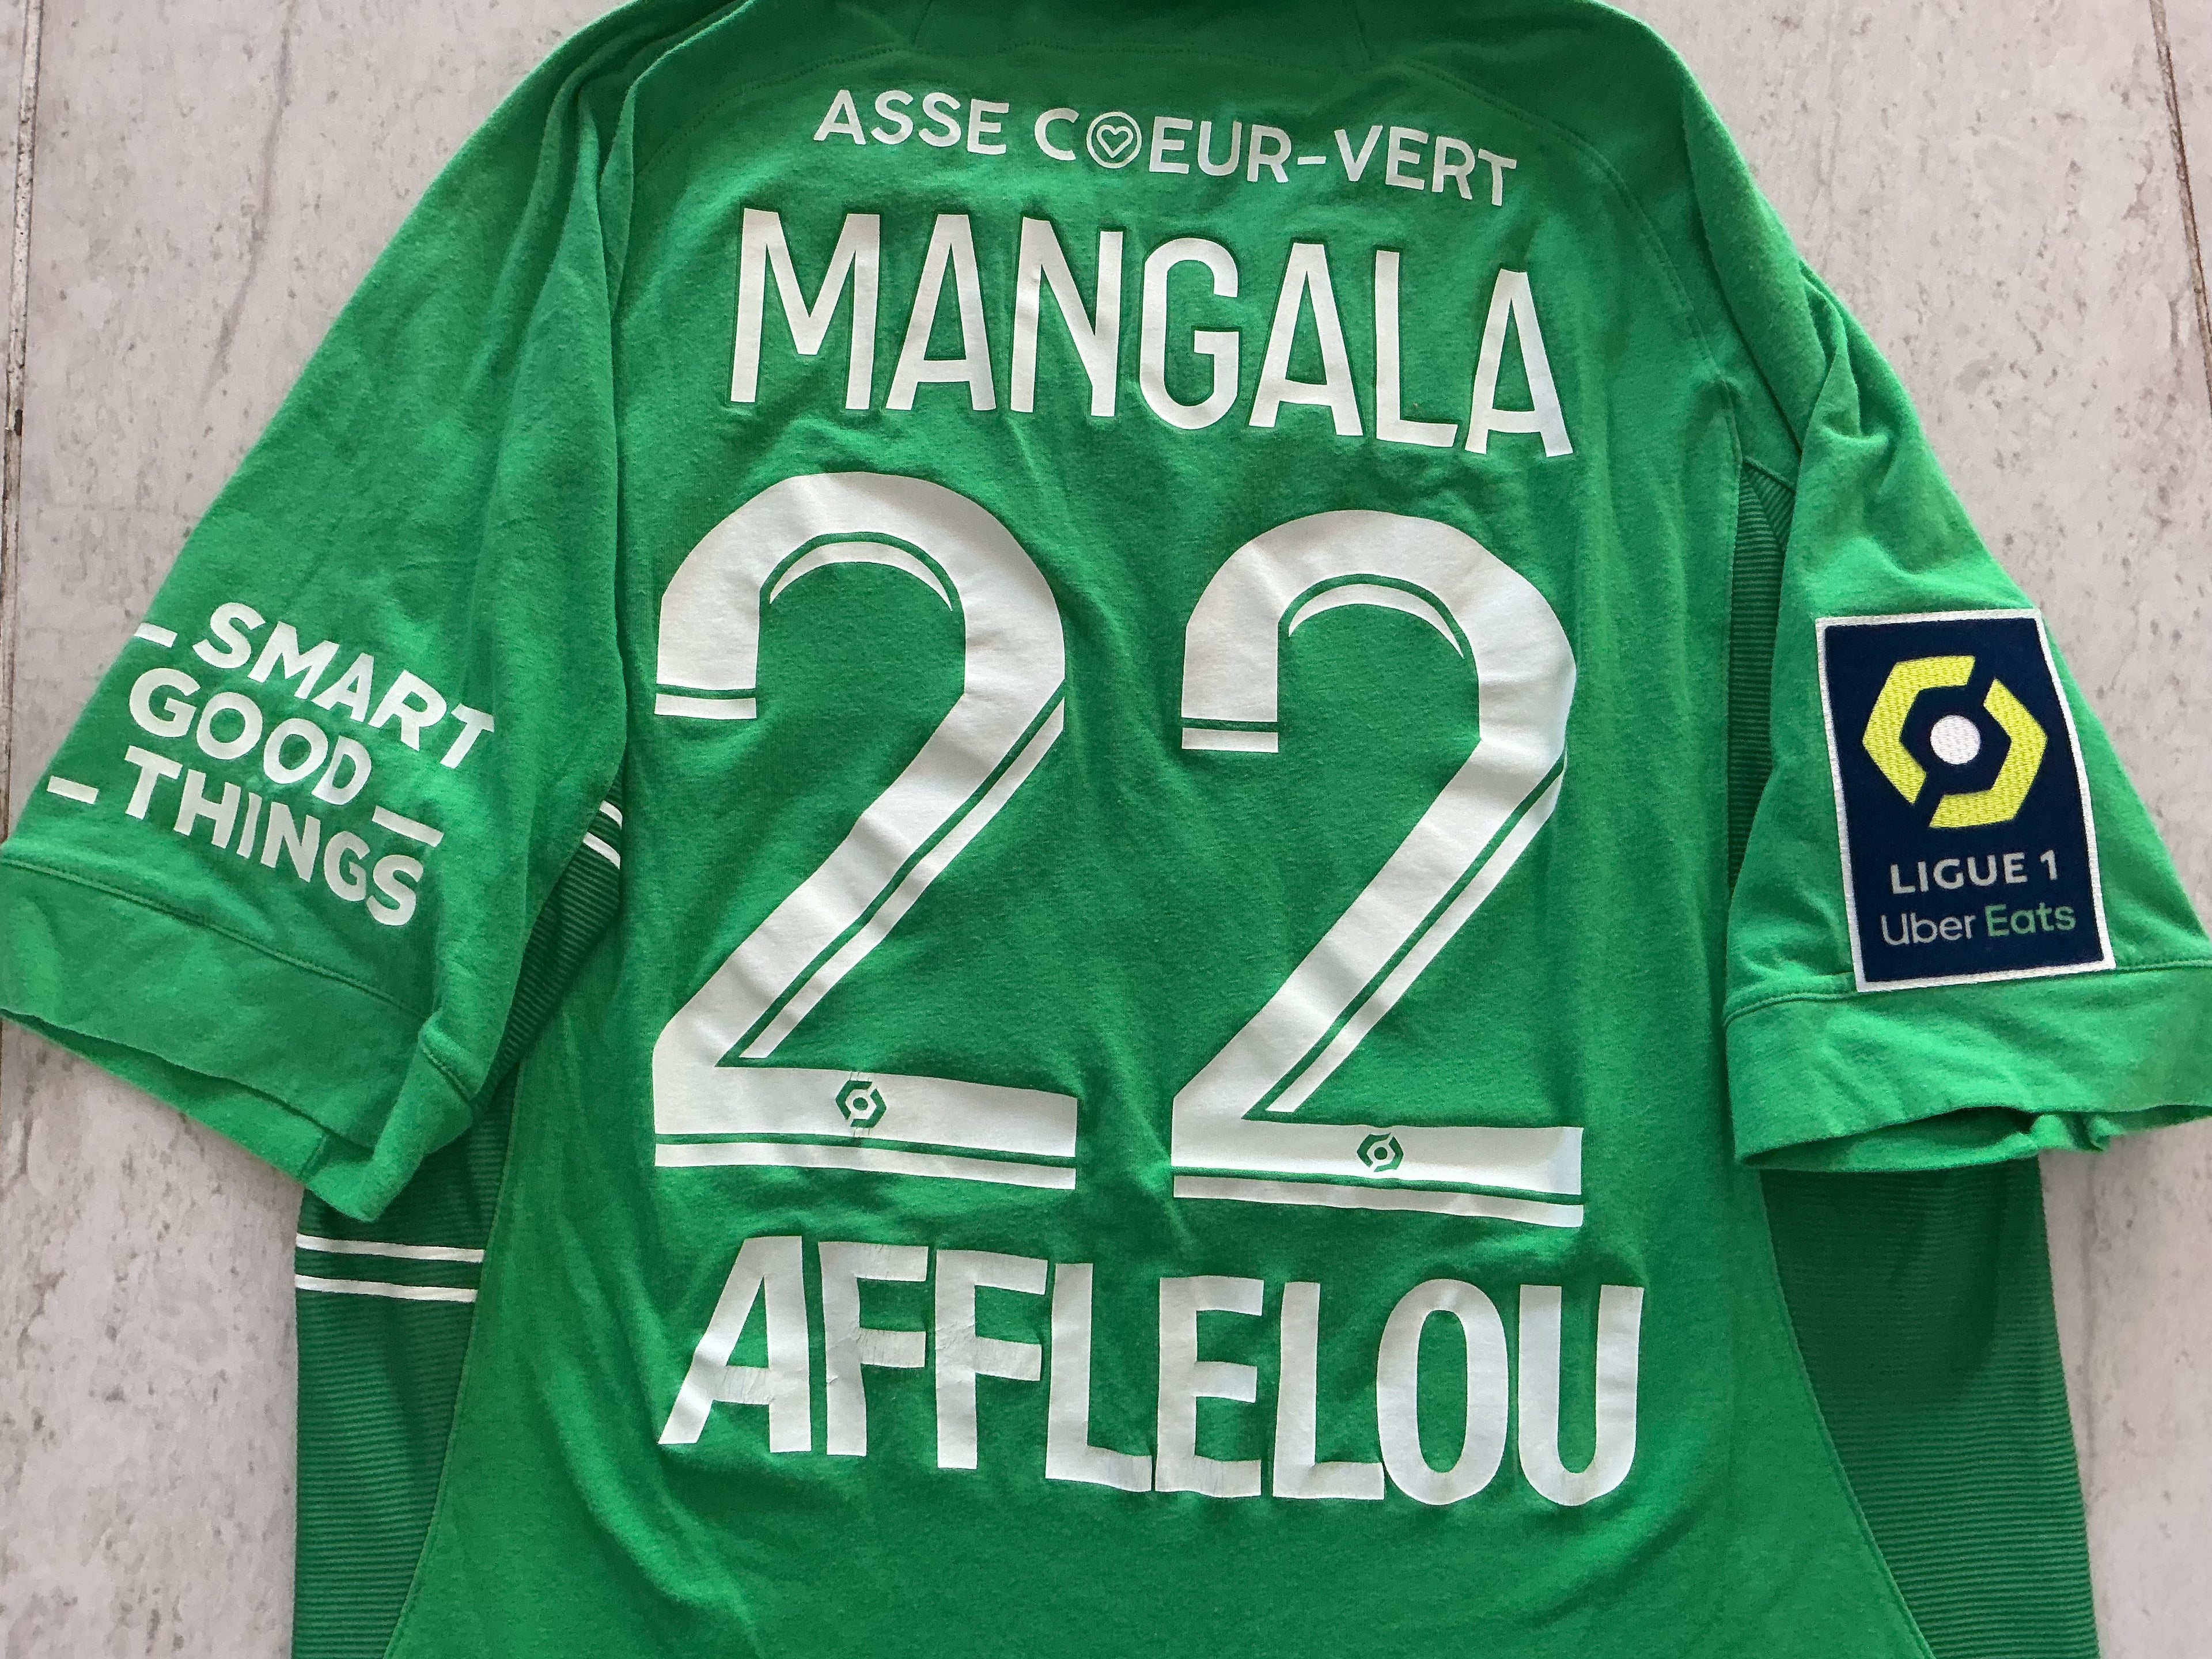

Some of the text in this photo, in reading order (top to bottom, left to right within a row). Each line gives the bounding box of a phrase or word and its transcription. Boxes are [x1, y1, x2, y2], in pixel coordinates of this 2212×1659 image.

[813, 89, 1010, 155] ASSE
[729, 207, 1574, 459] MANGALA
[128, 667, 372, 805] GOOD
[192, 602, 495, 770] SMART
[124, 745, 424, 926] THINGS
[651, 471, 1585, 1229] 22
[1889, 849, 2059, 895] LIGUE 1
[1880, 902, 2076, 946] Uber Eats
[657, 1236, 1645, 1506] AFFLELOU
